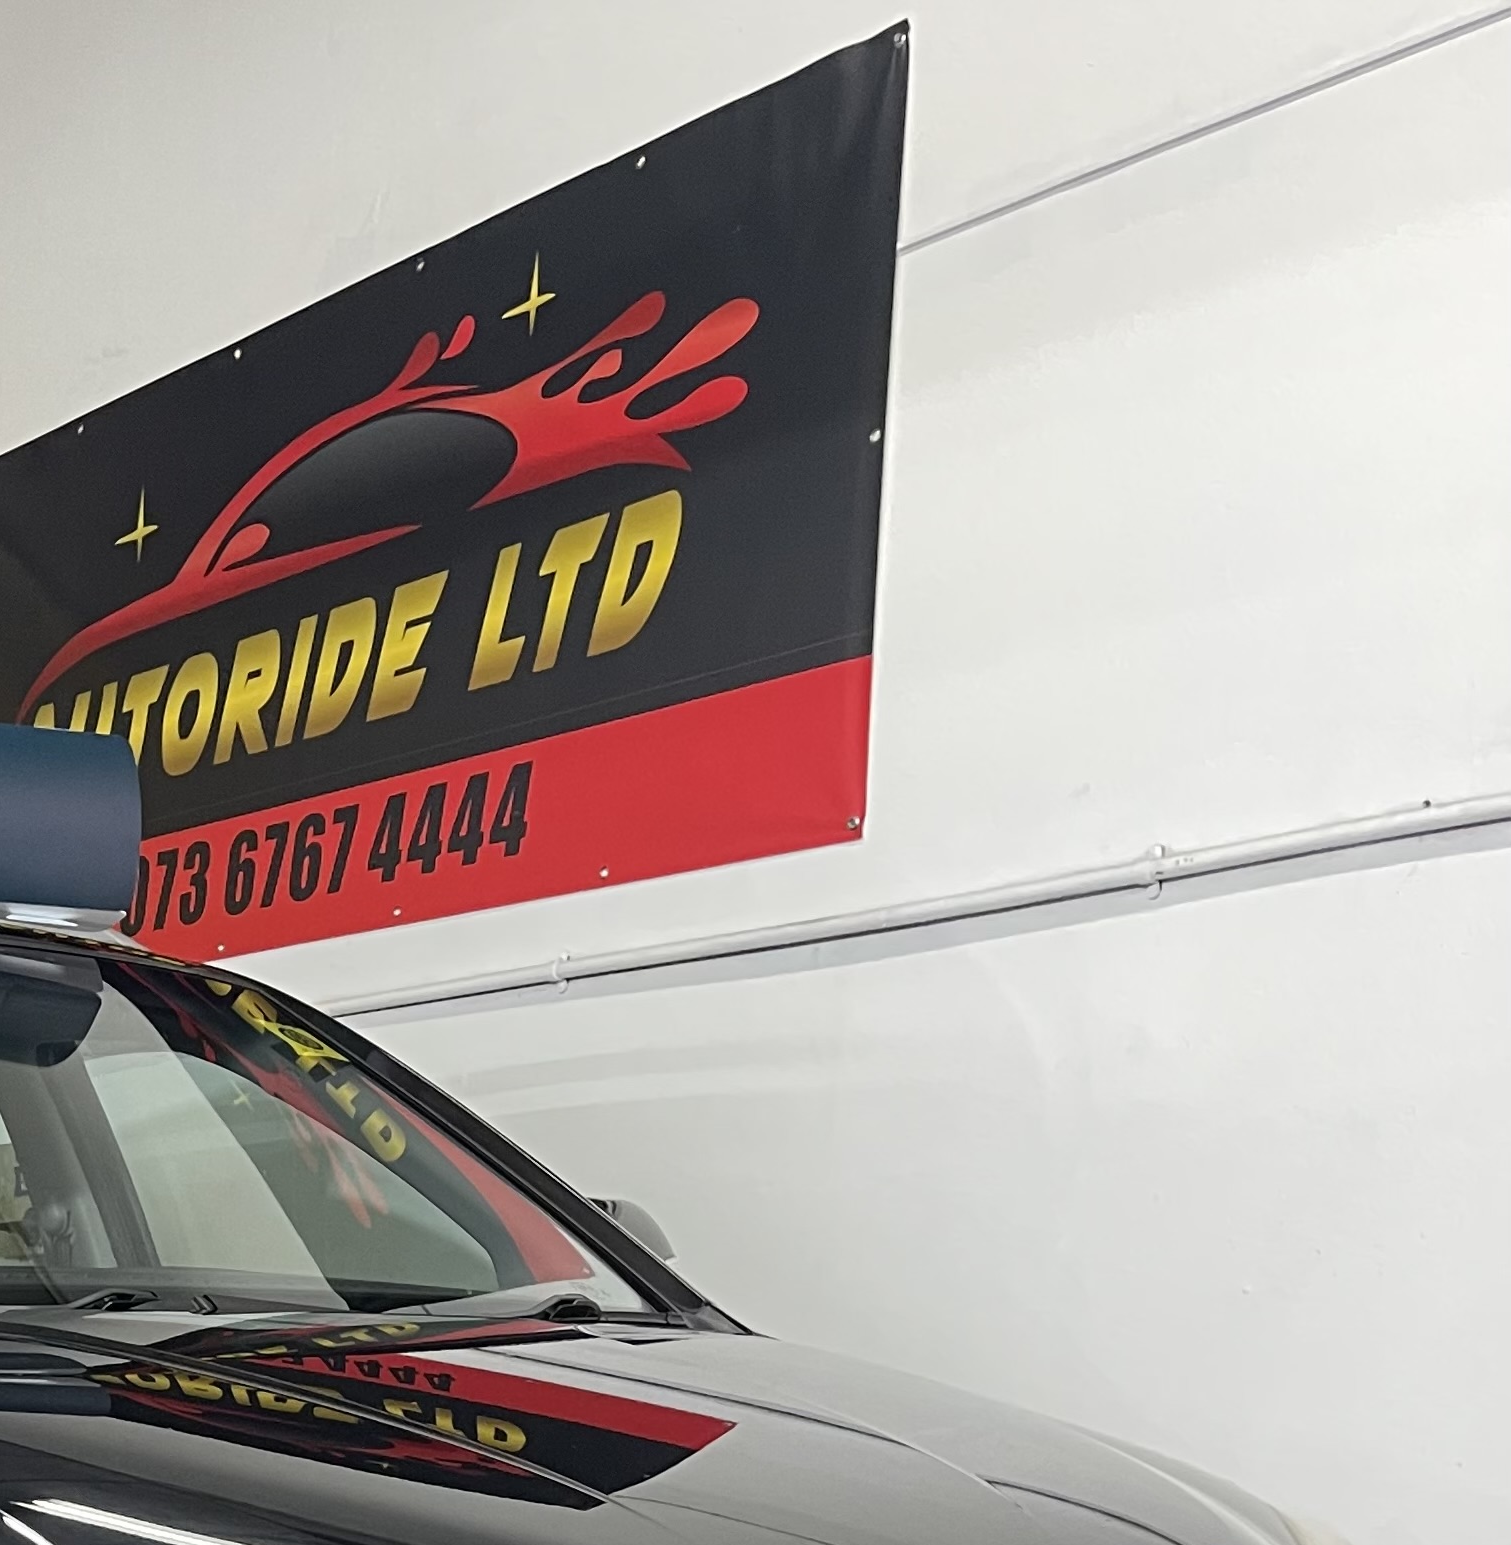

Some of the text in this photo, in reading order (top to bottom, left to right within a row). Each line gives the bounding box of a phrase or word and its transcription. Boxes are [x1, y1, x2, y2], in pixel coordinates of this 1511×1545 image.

[467, 488, 684, 691] LTD
[224, 804, 360, 916] 6767
[367, 761, 534, 883] 4444
